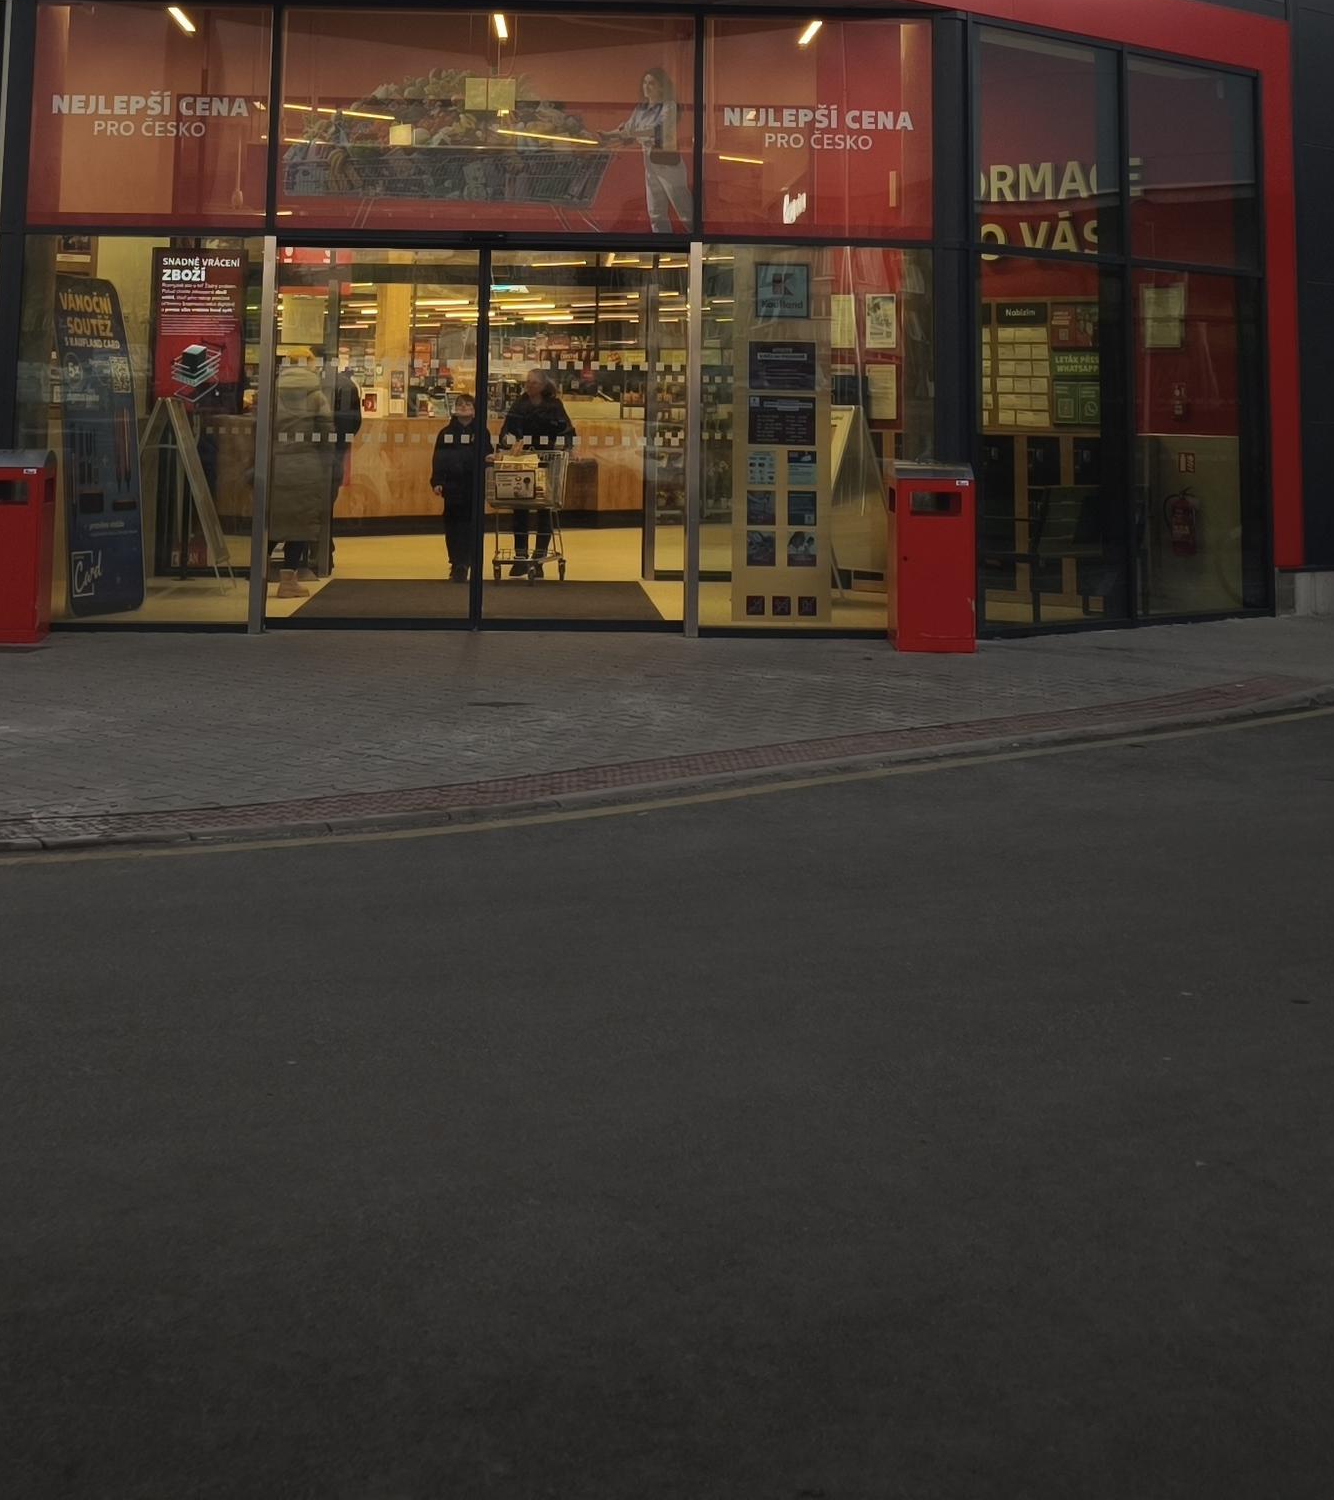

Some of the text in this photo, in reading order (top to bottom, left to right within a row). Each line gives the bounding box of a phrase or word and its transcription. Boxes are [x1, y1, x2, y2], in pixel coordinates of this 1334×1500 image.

[51, 90, 250, 117] NEJLEPŠÍ CENA
[93, 118, 206, 137] PRO ČESKO
[723, 104, 914, 131] NEJLEPŠÍ CENA
[764, 131, 873, 150] PRO ČESKO
[162, 256, 240, 267] SNADNÉ VRÁCENÍ
[161, 266, 206, 281] ZBOŽÍ
[59, 288, 113, 314] VÁNOČNÍ
[66, 315, 114, 337] SOUTĚŽ
[75, 549, 103, 593] Card
